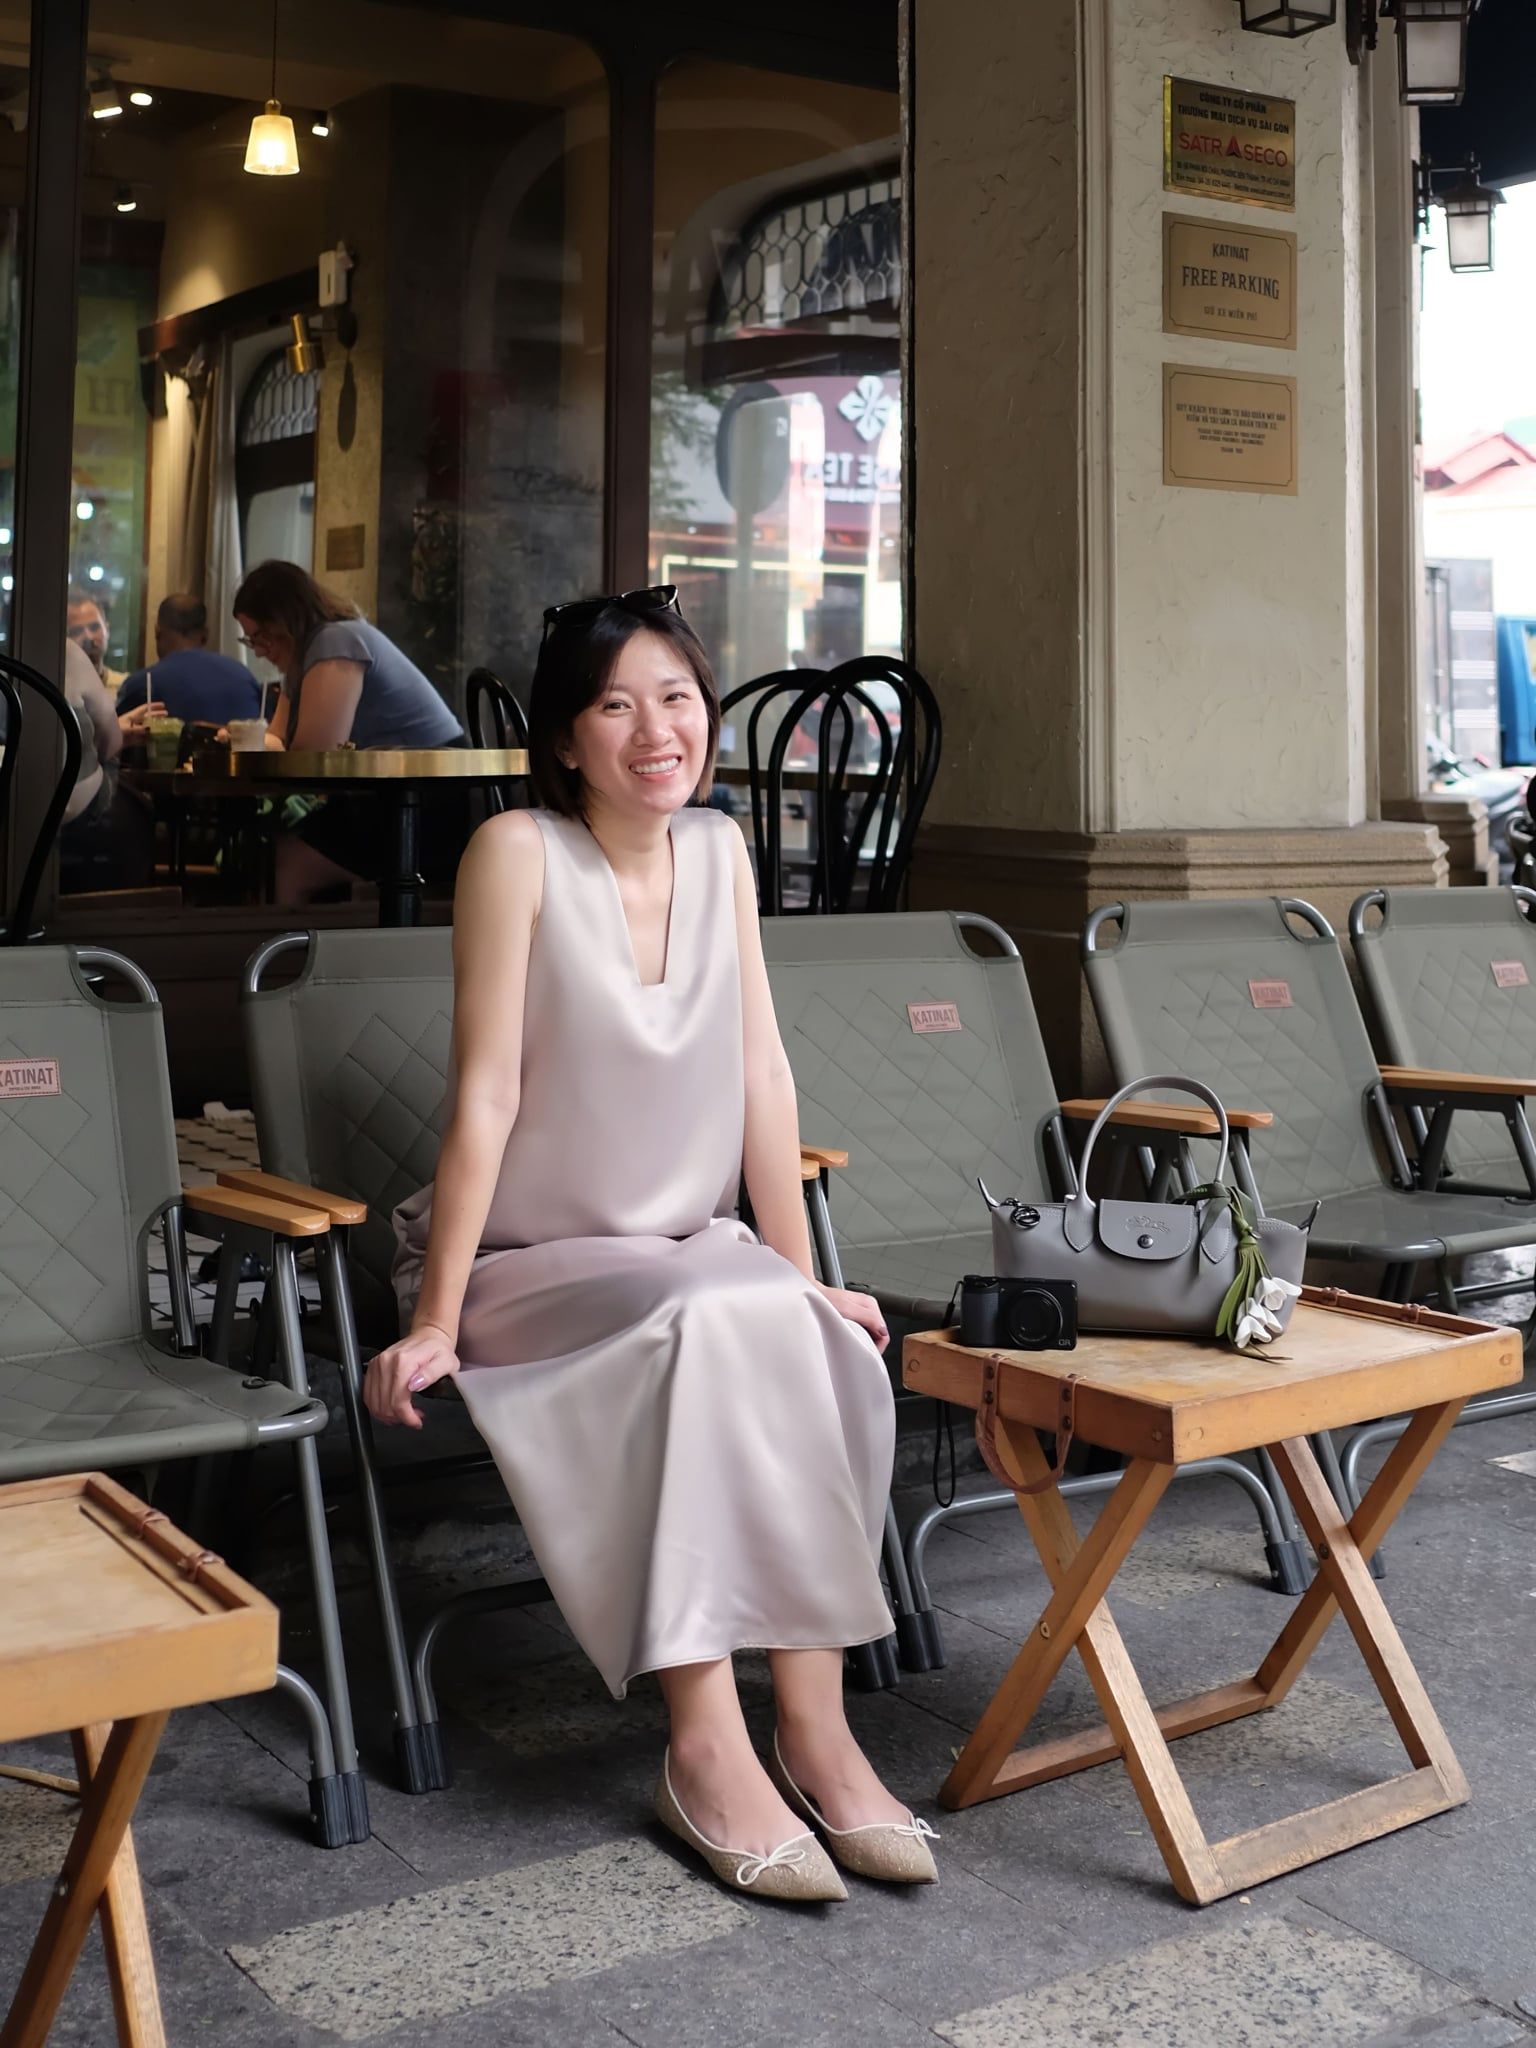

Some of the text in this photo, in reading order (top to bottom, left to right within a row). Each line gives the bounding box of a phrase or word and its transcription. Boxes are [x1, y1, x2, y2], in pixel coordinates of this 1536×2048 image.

[1212, 243, 1250, 262] KATINAT
[1182, 265, 1280, 300] FREE PARKING
[912, 1008, 955, 1025] KATINAT
